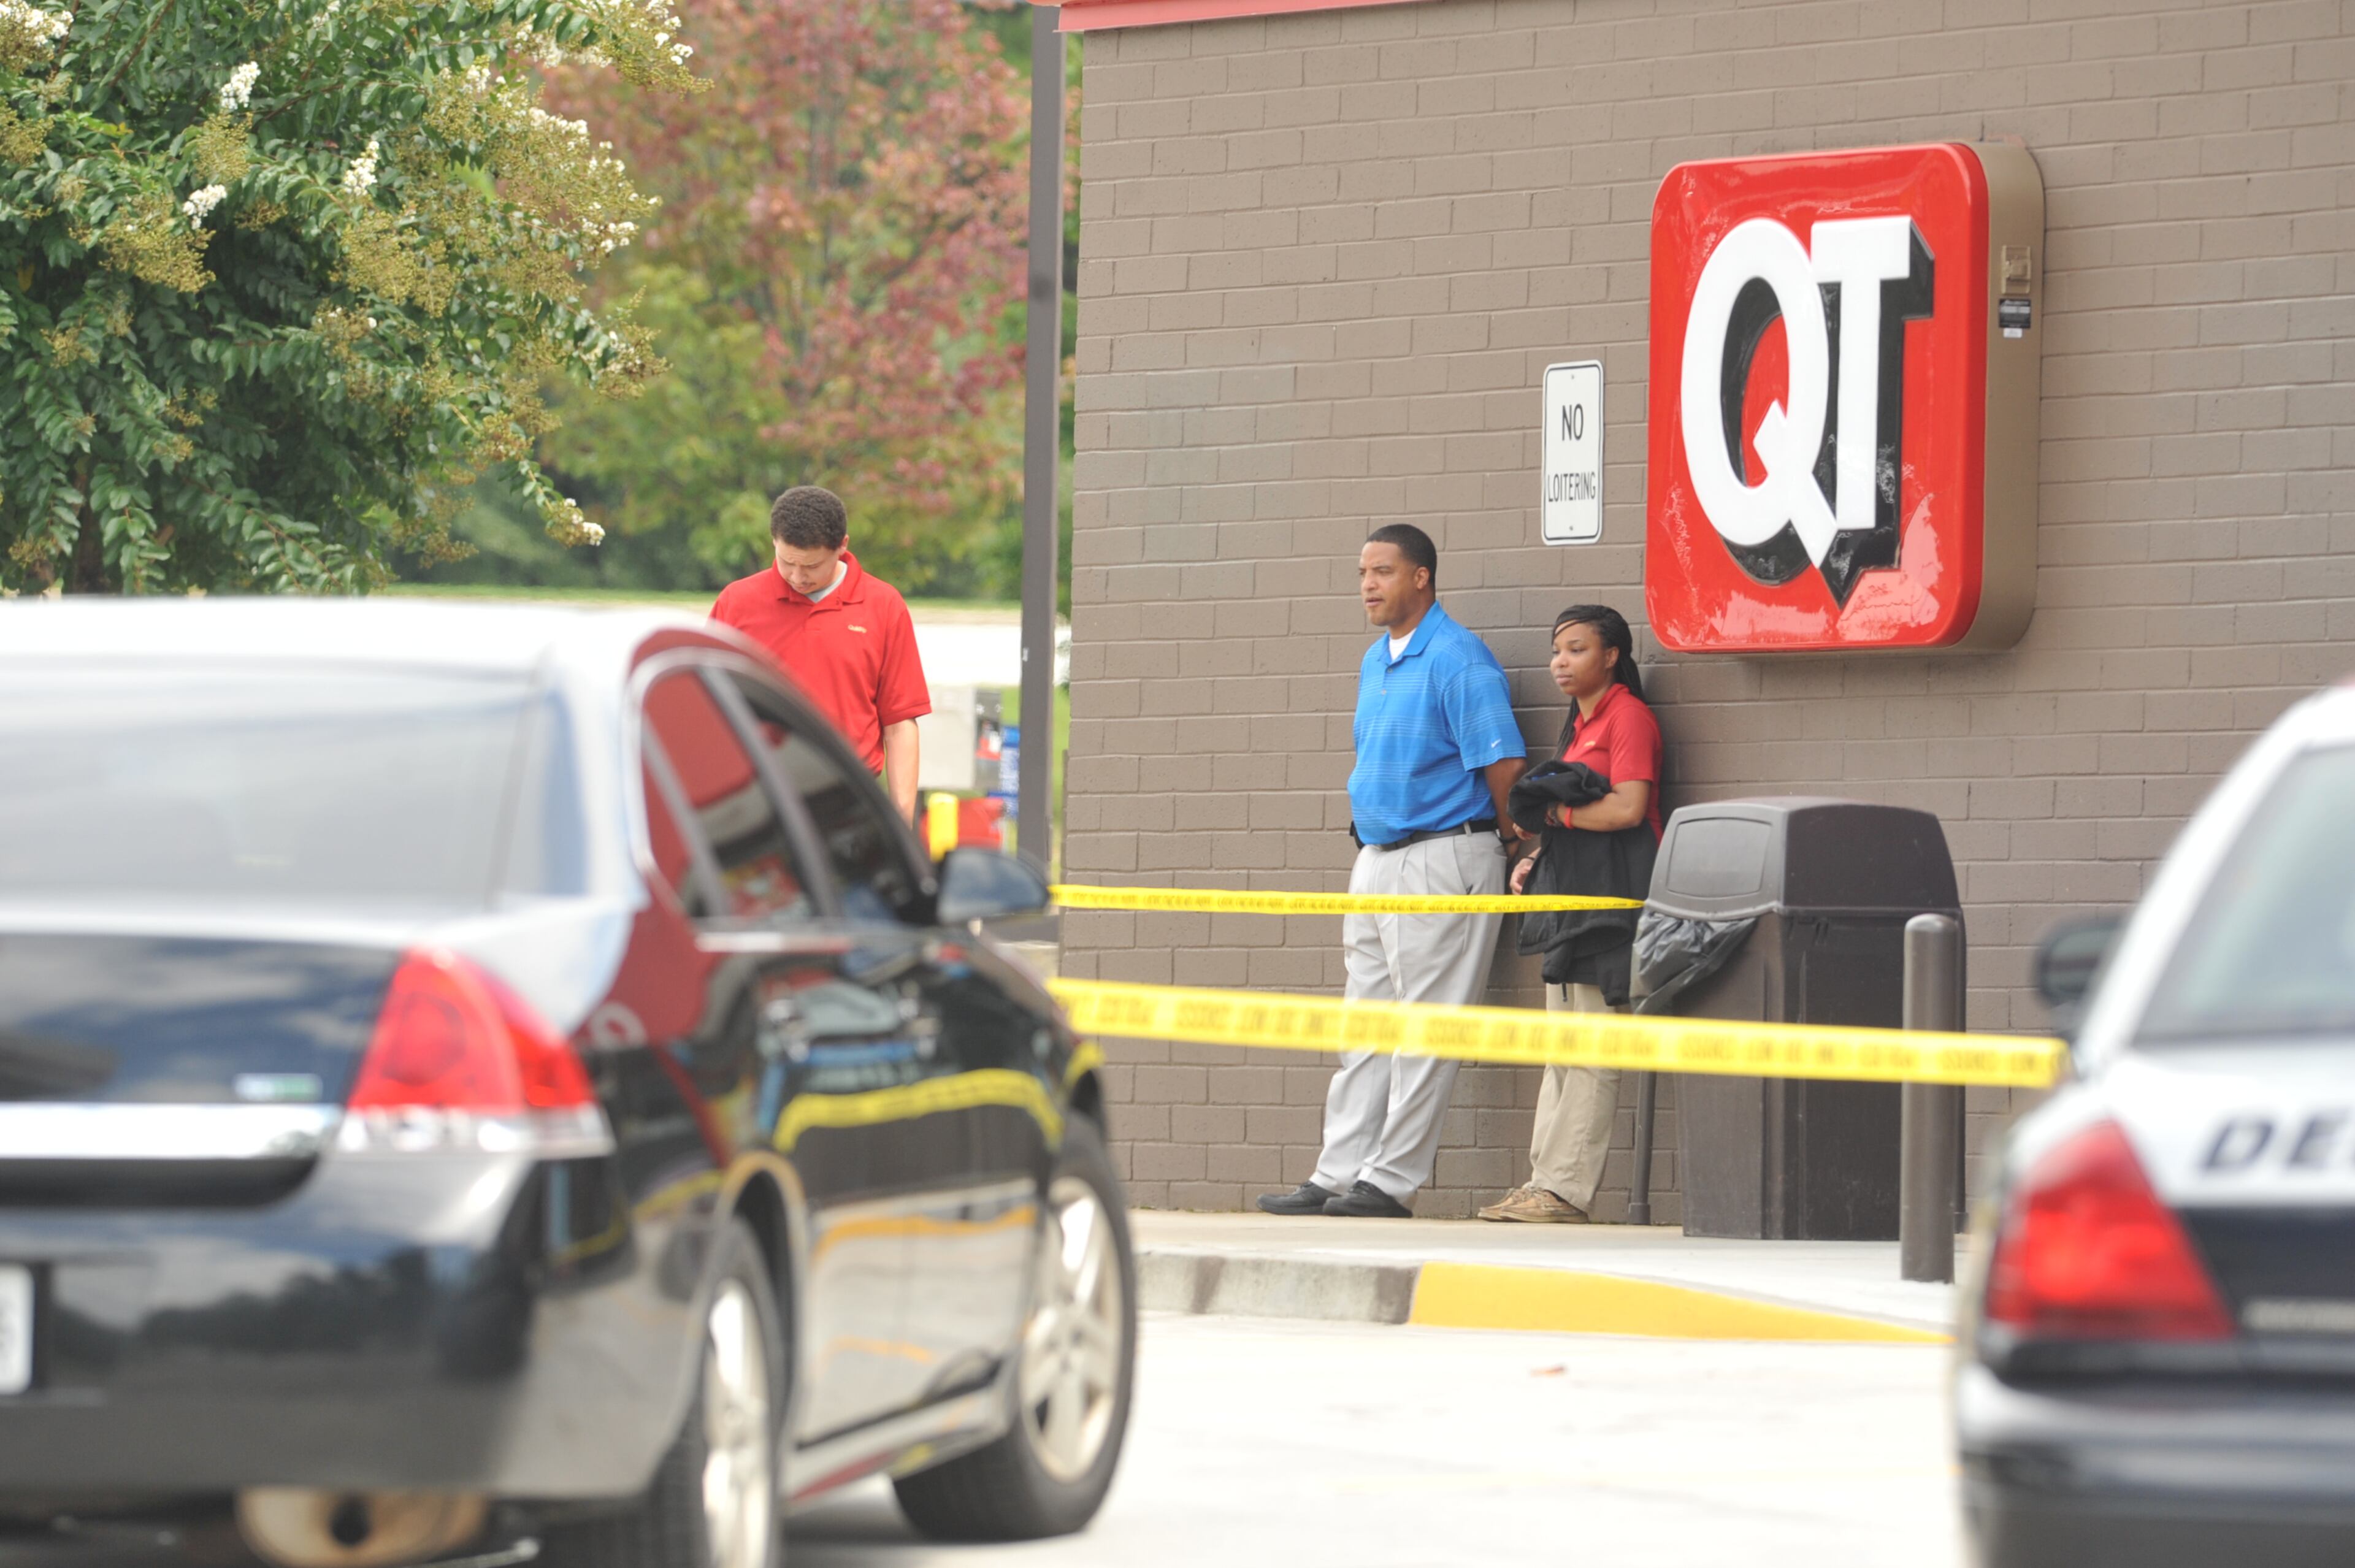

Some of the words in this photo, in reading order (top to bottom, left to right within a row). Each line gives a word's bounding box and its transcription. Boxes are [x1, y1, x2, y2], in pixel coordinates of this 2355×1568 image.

[1679, 215, 1912, 569] QT
[1562, 403, 1583, 441] NO
[1547, 472, 1596, 502] LOITERING
[2199, 1109, 2355, 1174] DE
